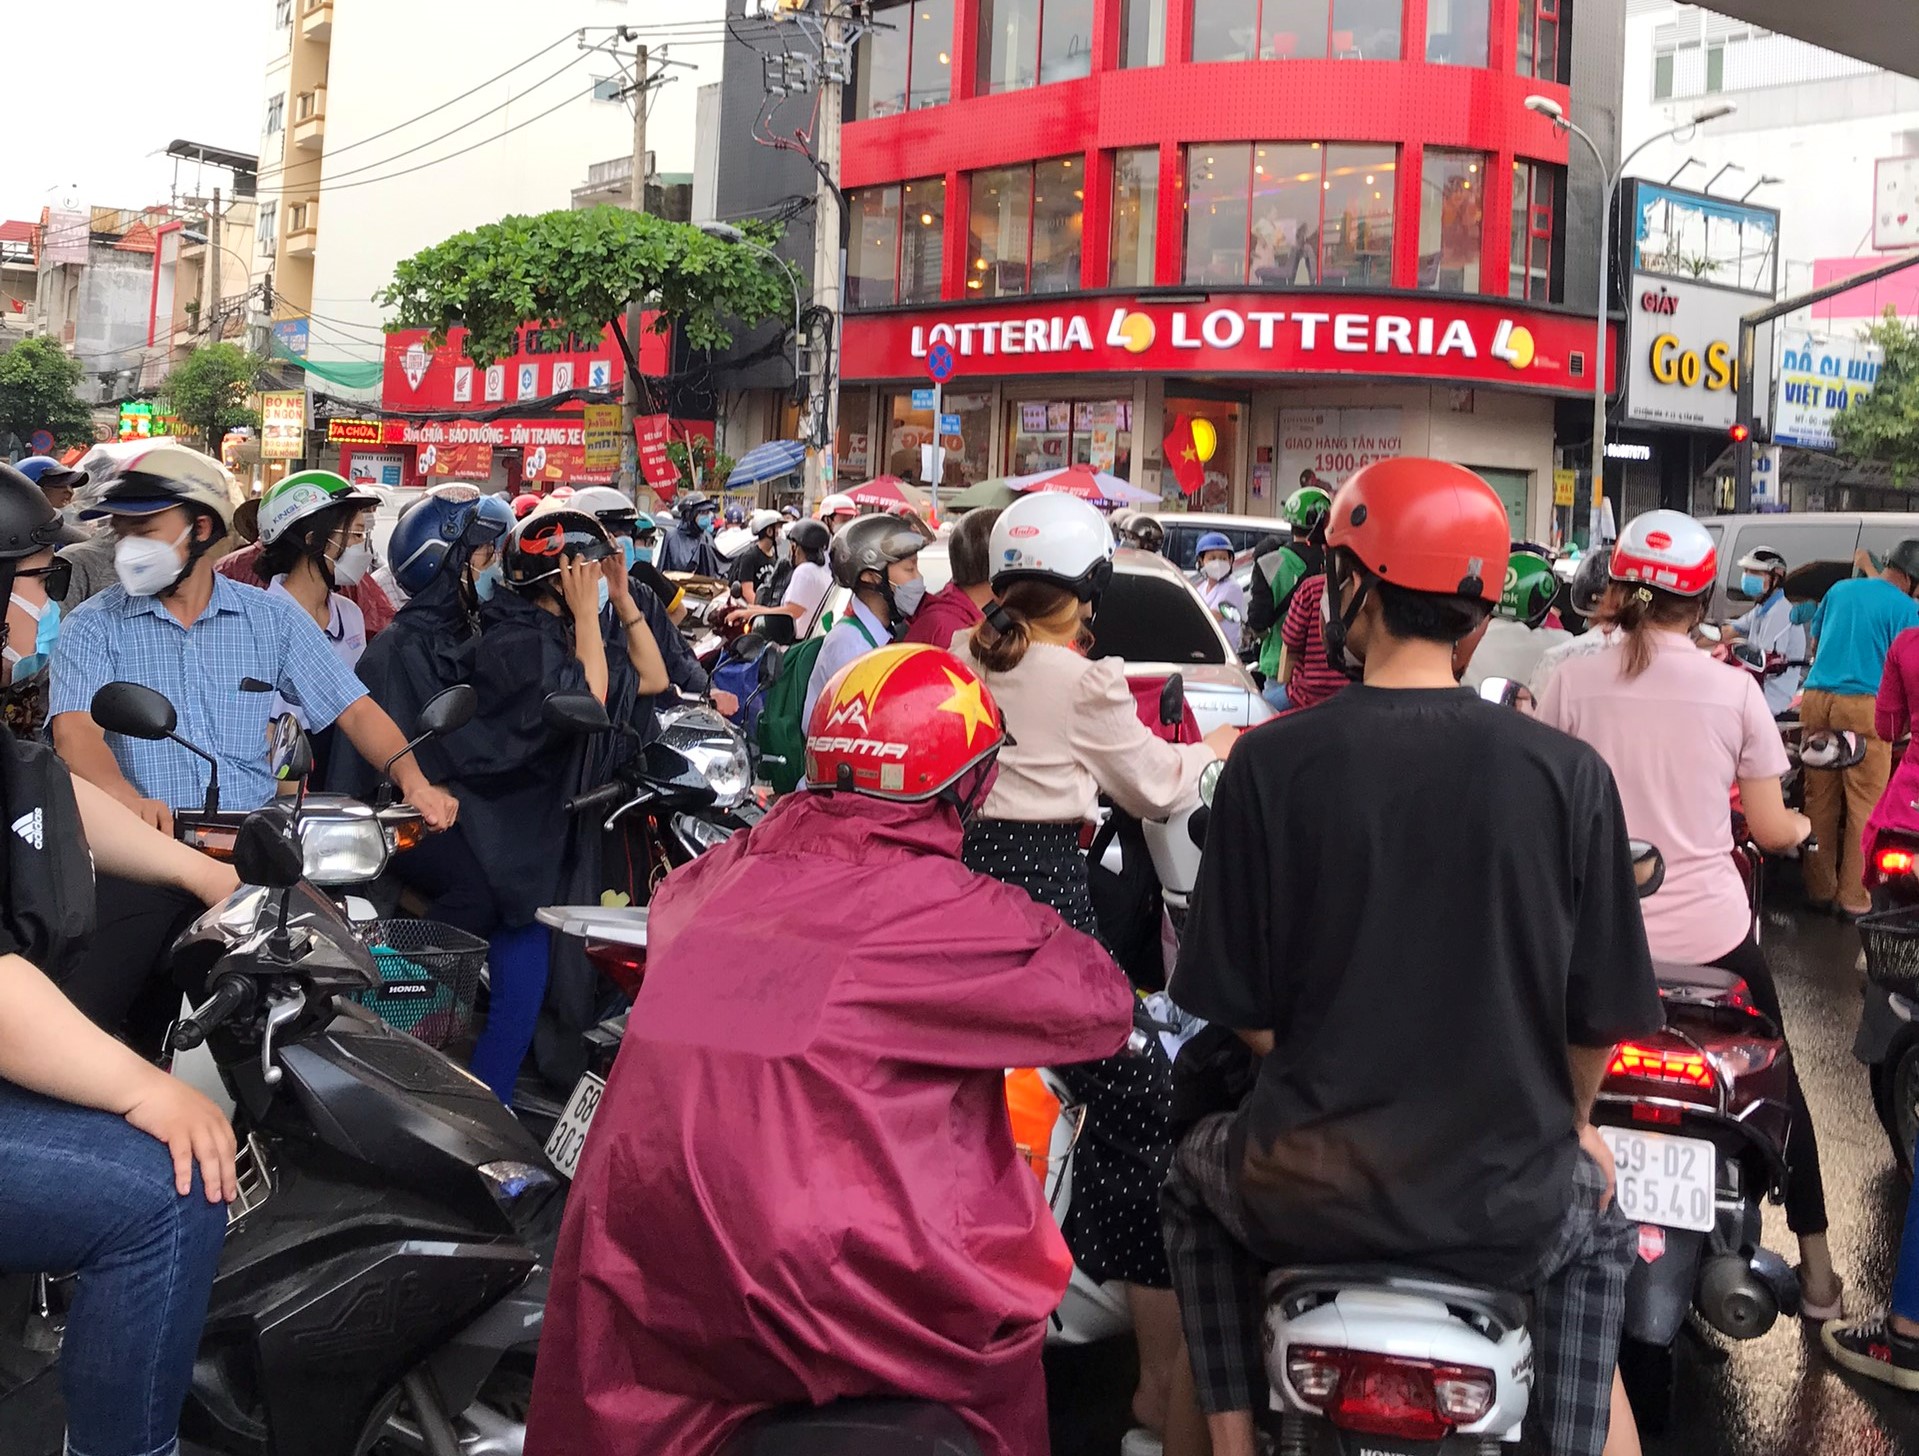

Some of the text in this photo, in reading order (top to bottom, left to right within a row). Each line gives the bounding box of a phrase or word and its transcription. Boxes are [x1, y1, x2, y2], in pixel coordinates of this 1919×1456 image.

[1641, 286, 1680, 315] GIÀY
[911, 316, 1093, 357] LOTTERIA
[1172, 309, 1477, 358] LOTTERIA
[265, 409, 271, 419] 3
[171, 422, 198, 436] INDIA
[510, 423, 530, 444] TÂN
[531, 427, 566, 445] TRANG
[567, 428, 582, 445] XE
[1285, 437, 1313, 451] GIAO
[1315, 434, 1348, 450] HÀNG
[1315, 453, 1401, 472] 1900-6
[34, 807, 43, 850] adidas
[389, 984, 427, 994] HONDA
